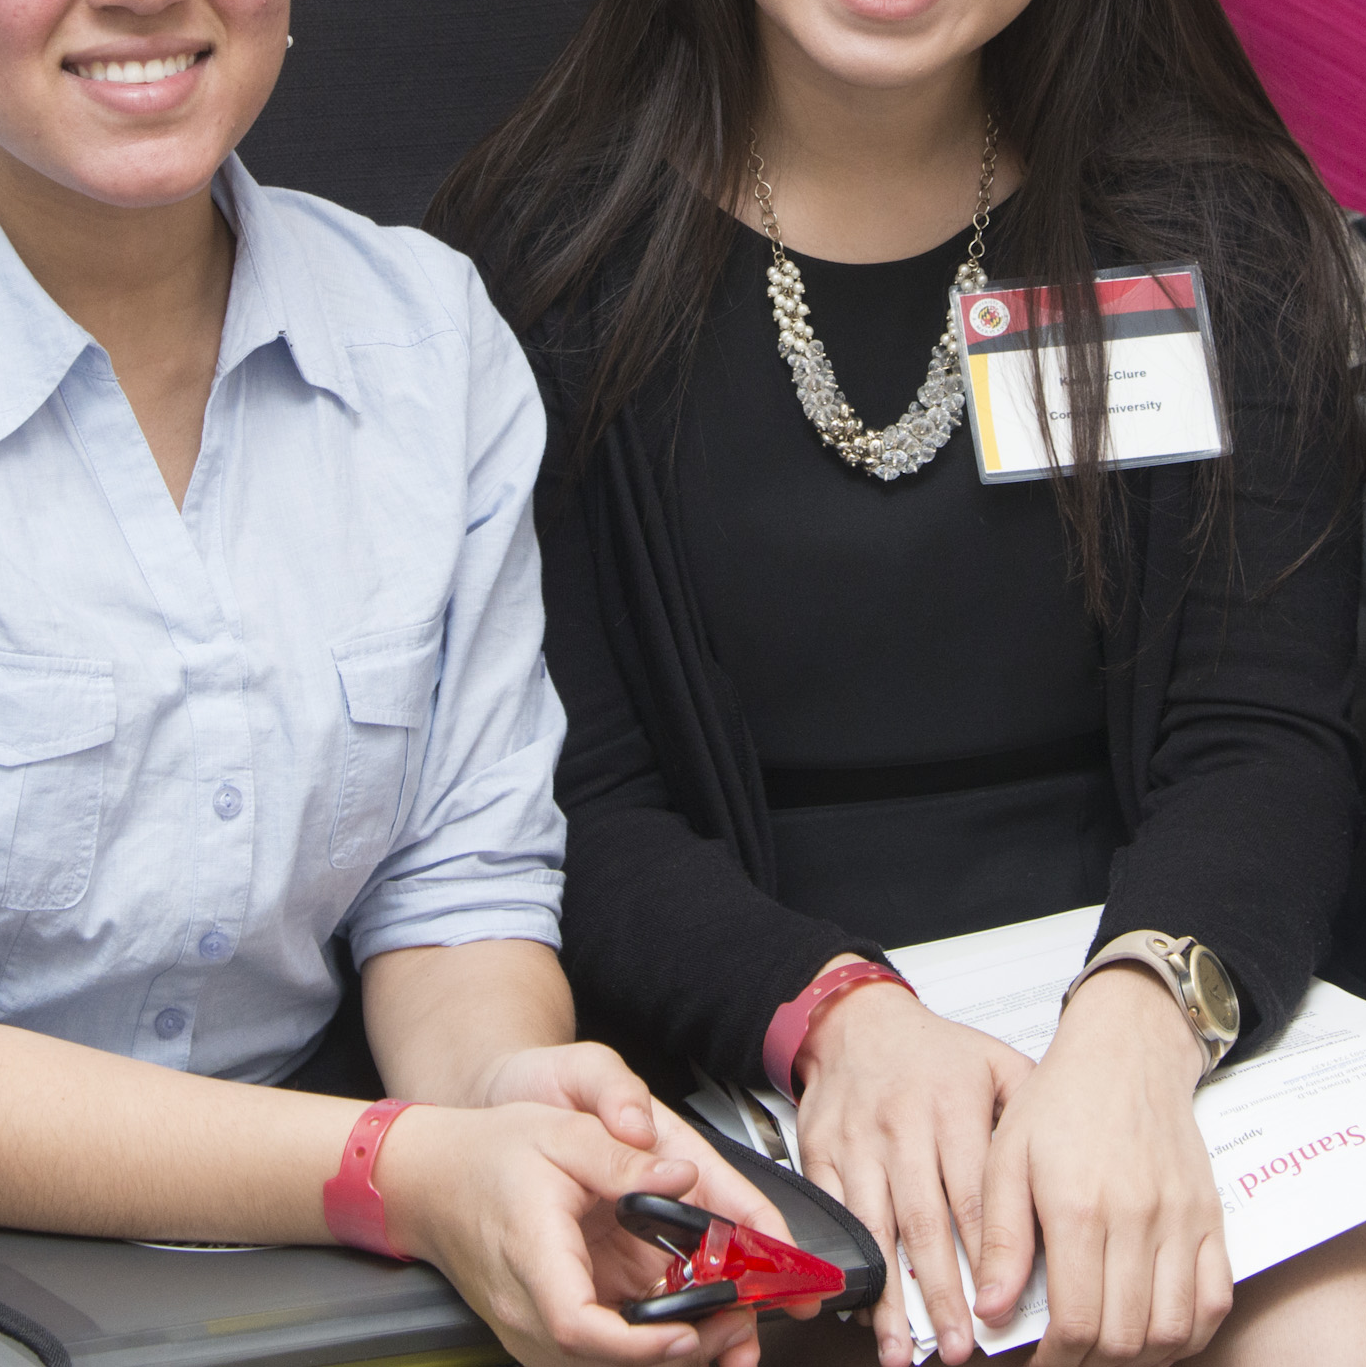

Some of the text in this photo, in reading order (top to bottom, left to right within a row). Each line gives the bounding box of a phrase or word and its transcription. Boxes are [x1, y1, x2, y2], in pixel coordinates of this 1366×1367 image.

[1106, 368, 1148, 382] cClure
[1108, 399, 1163, 415] niversity
[1305, 1070, 1345, 1087] Diversity
[1250, 1084, 1304, 1108] Recruitment
[1220, 1103, 1248, 1118] Officer
[1214, 1128, 1263, 1155] Applying
[1238, 1124, 1366, 1198] Stanford
